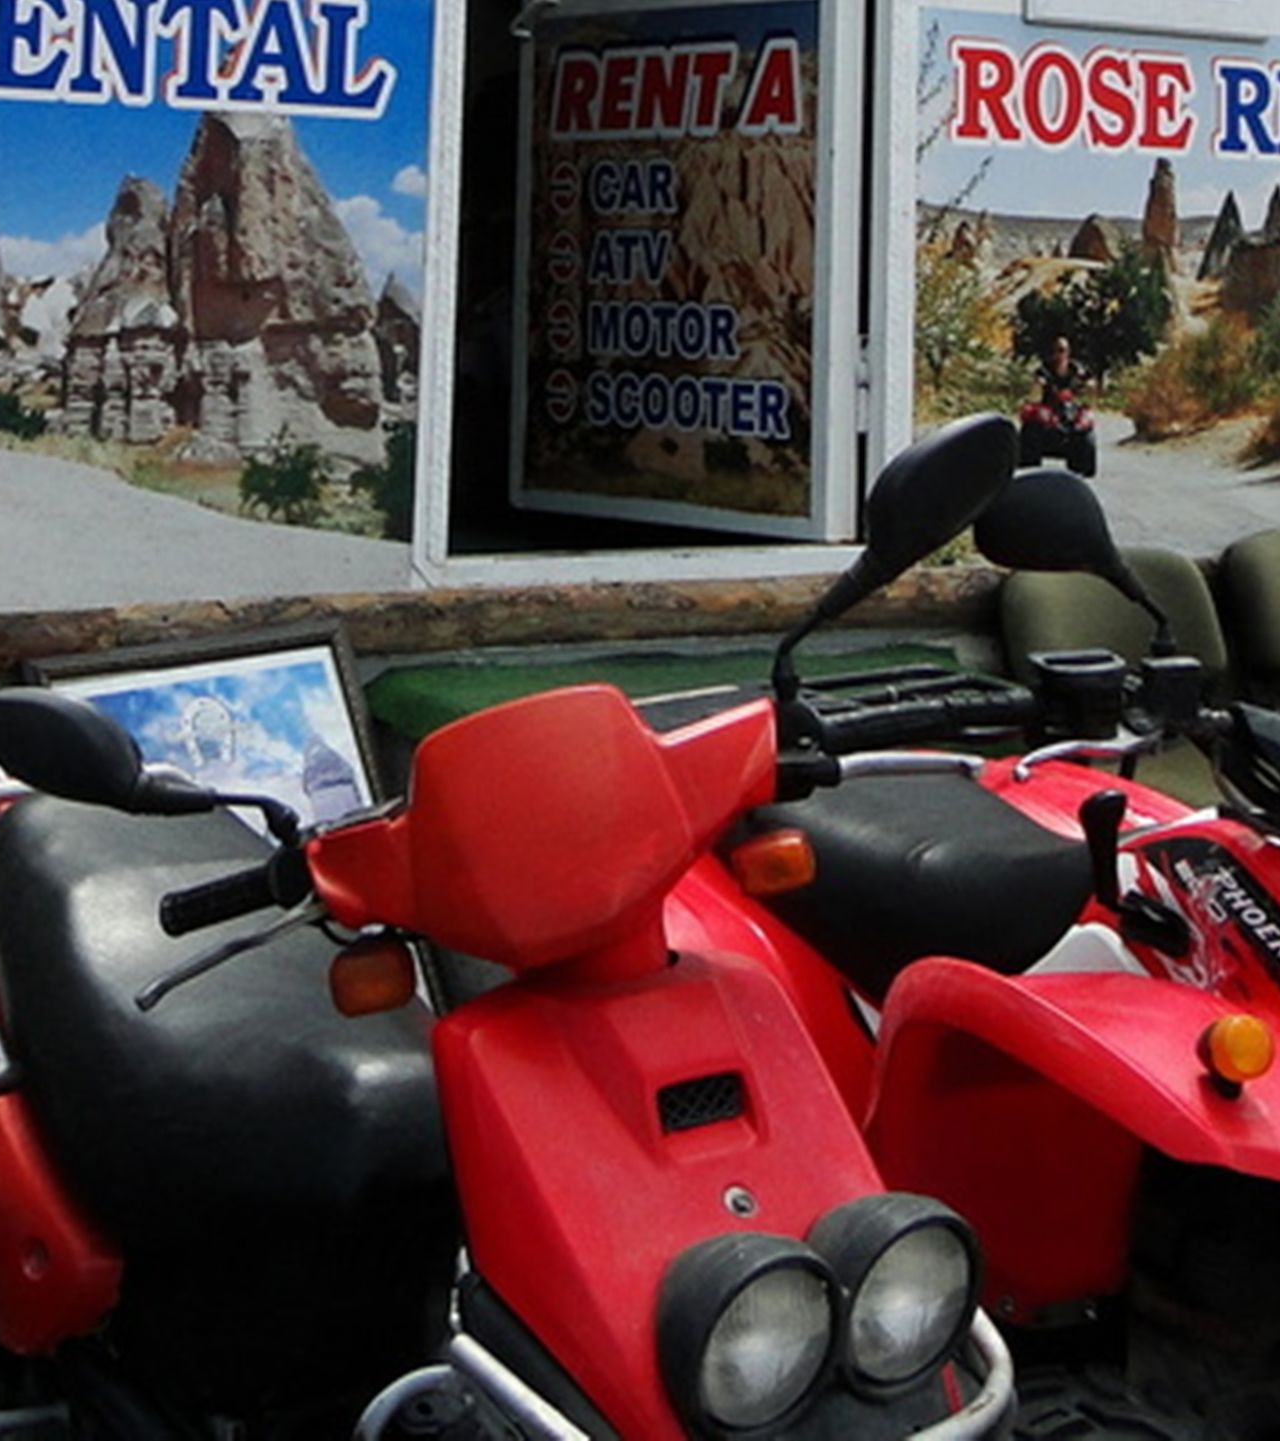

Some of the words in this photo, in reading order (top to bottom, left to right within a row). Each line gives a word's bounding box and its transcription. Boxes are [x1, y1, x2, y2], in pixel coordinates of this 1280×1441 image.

[552, 46, 734, 137] RENT
[741, 38, 803, 134] A
[953, 42, 1195, 152] ROSE
[589, 162, 677, 215] CAR
[586, 229, 675, 287] ATV
[587, 303, 740, 361] MOTOR
[584, 372, 792, 440] SCOOTER
